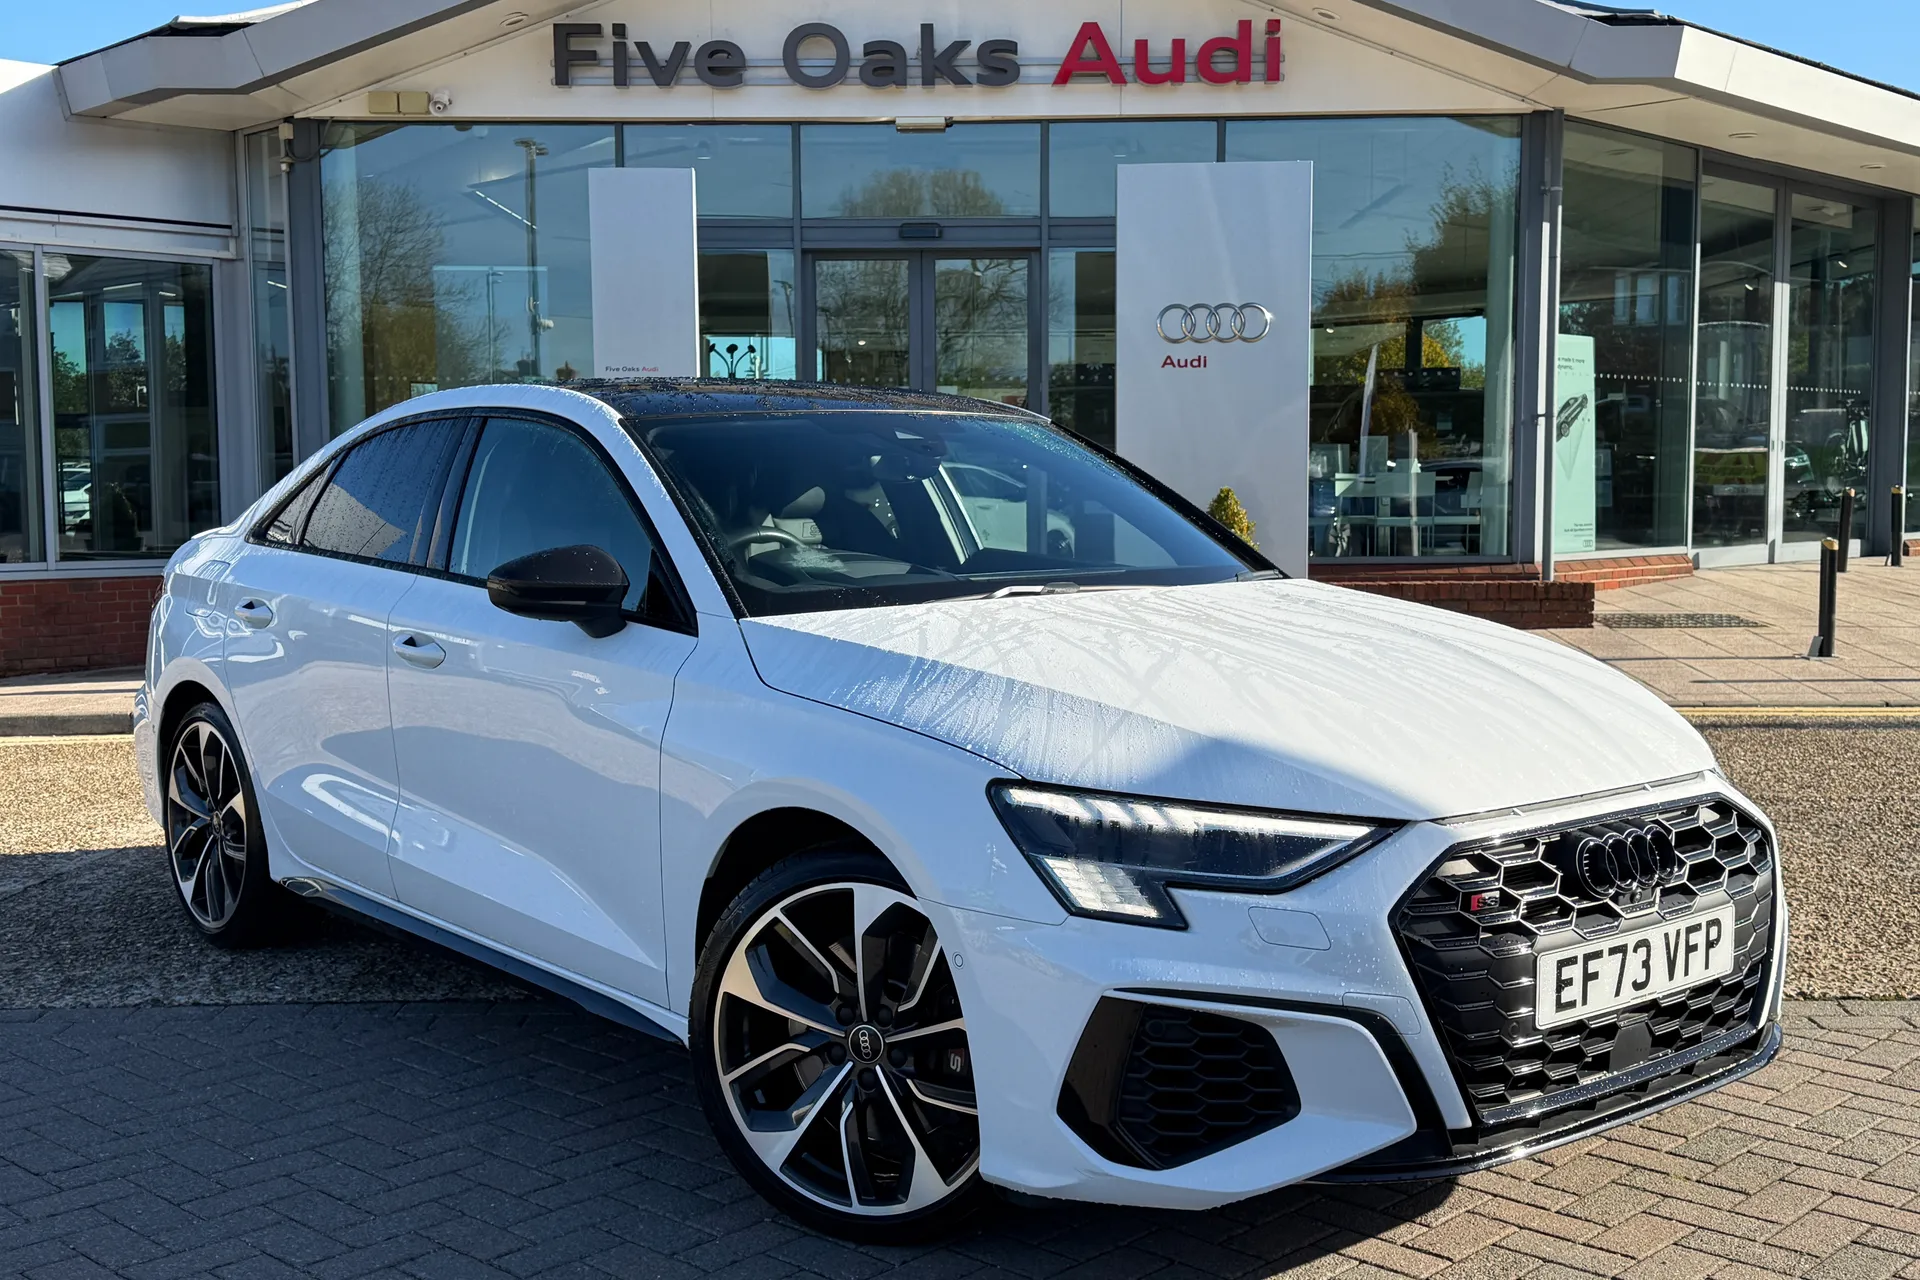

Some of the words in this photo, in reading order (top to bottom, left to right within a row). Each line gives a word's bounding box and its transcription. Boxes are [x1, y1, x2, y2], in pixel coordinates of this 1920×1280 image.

[553, 23, 747, 89] Five
[782, 22, 1021, 89] Oaks
[1051, 19, 1281, 86] Audi
[1161, 355, 1207, 368] Audi
[1555, 938, 1652, 1014] EF73
[1663, 917, 1722, 983] VFP
[950, 1053, 961, 1072] S
